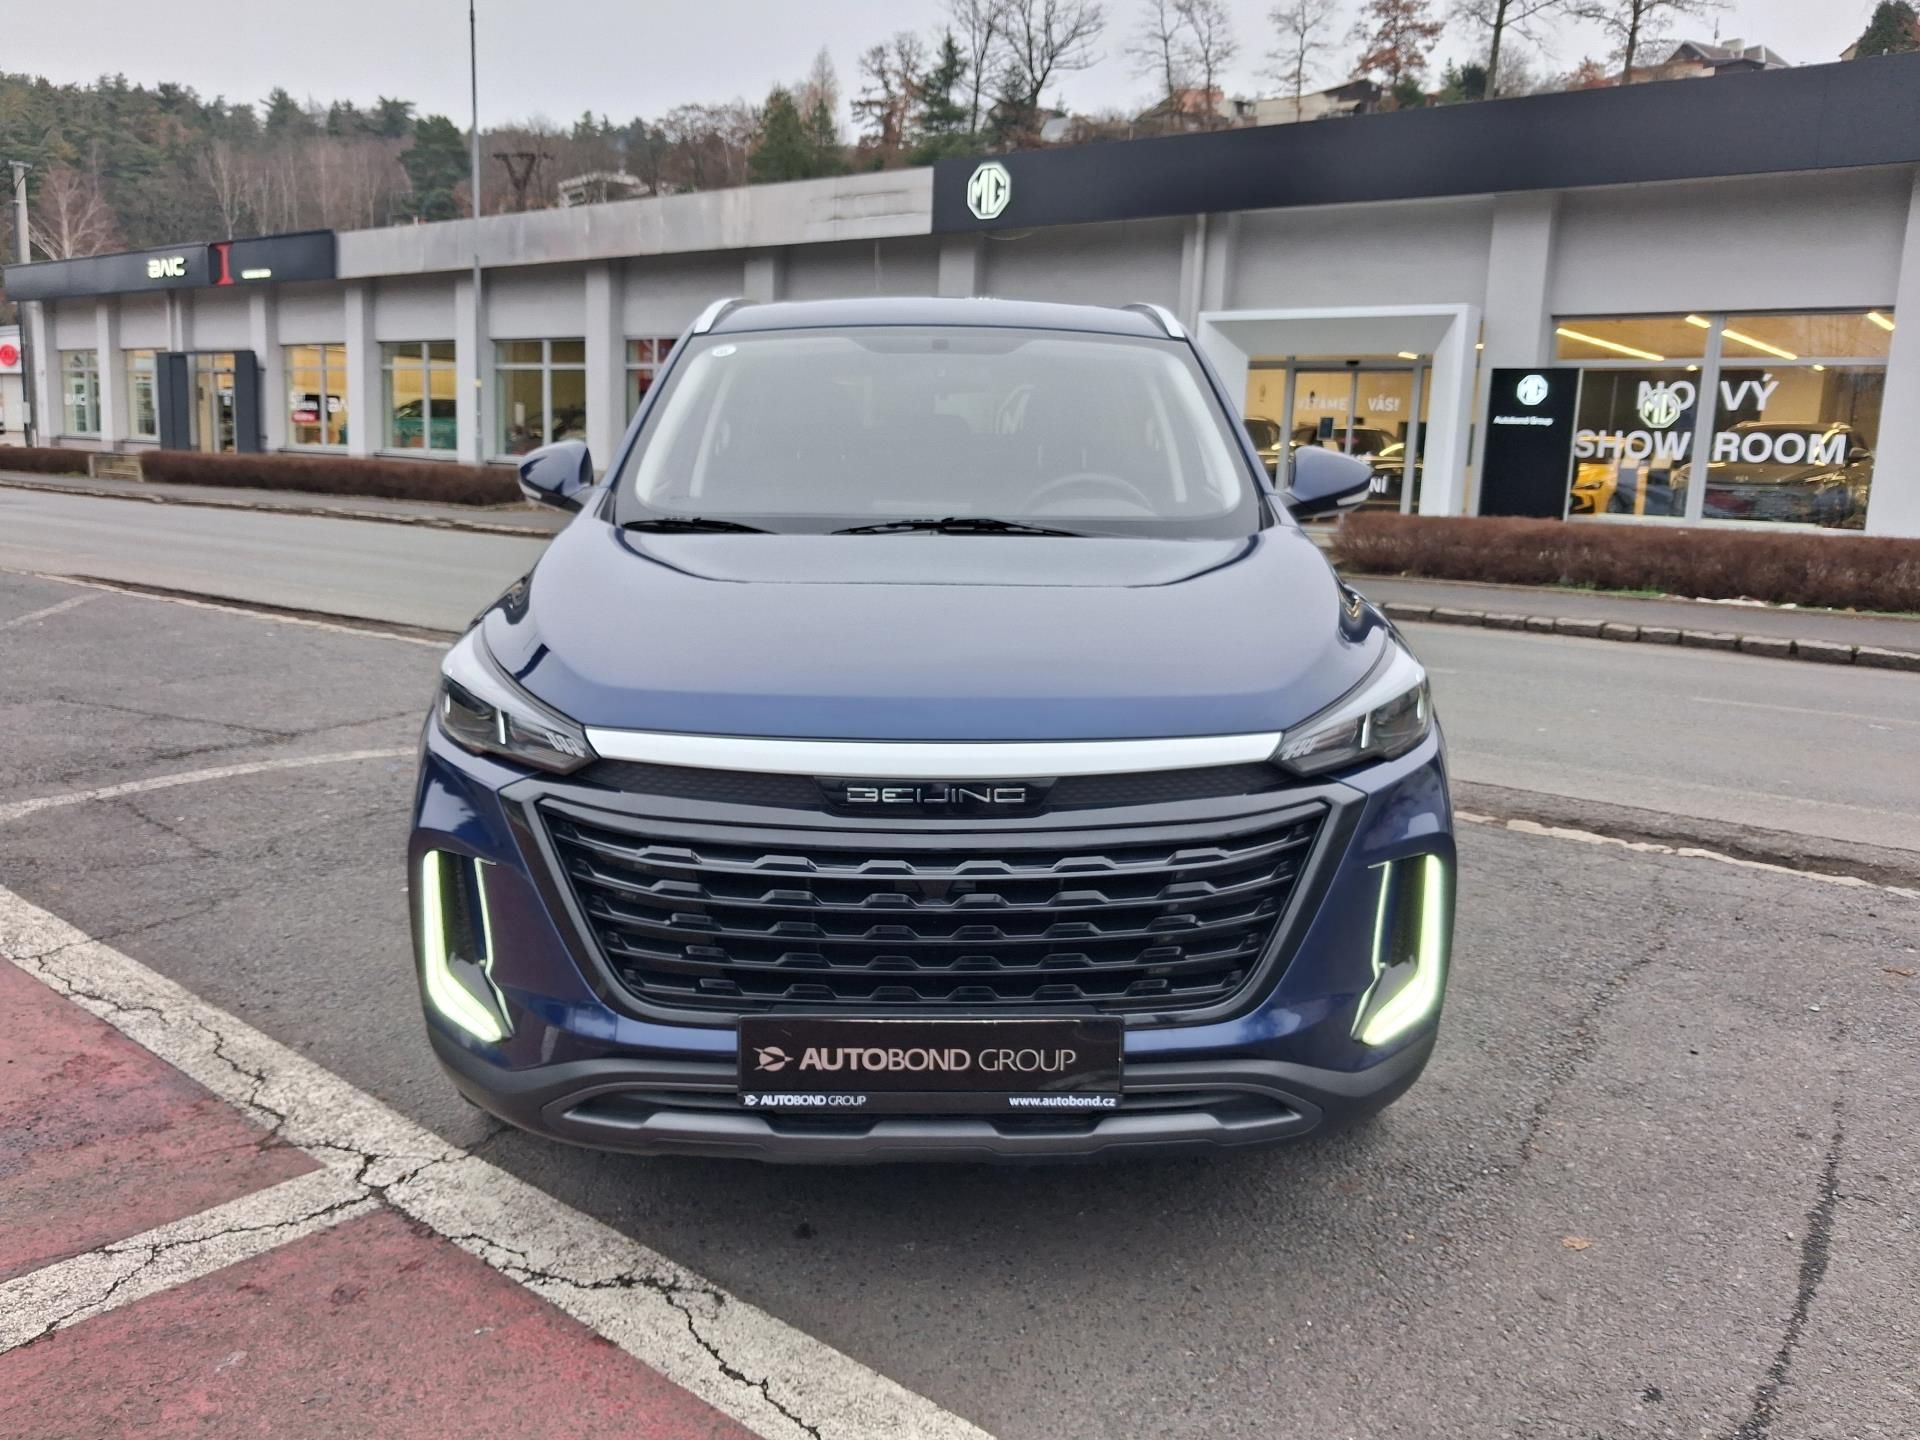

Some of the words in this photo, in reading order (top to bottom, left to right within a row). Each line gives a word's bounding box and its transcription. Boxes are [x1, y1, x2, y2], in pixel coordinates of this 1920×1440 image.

[968, 164, 1009, 217] MG
[1719, 373, 1779, 411] VÝ
[1574, 429, 1691, 460] SHOW
[1712, 431, 1847, 464] ROOM
[847, 787, 1026, 803] BEIJING
[799, 1048, 971, 1072] AUTOBOND
[978, 1049, 1077, 1072] GROUP
[760, 1095, 826, 1106] AUTOBOND
[828, 1095, 866, 1106] GROUP
[1008, 1095, 1116, 1107] www.autobond.cz
